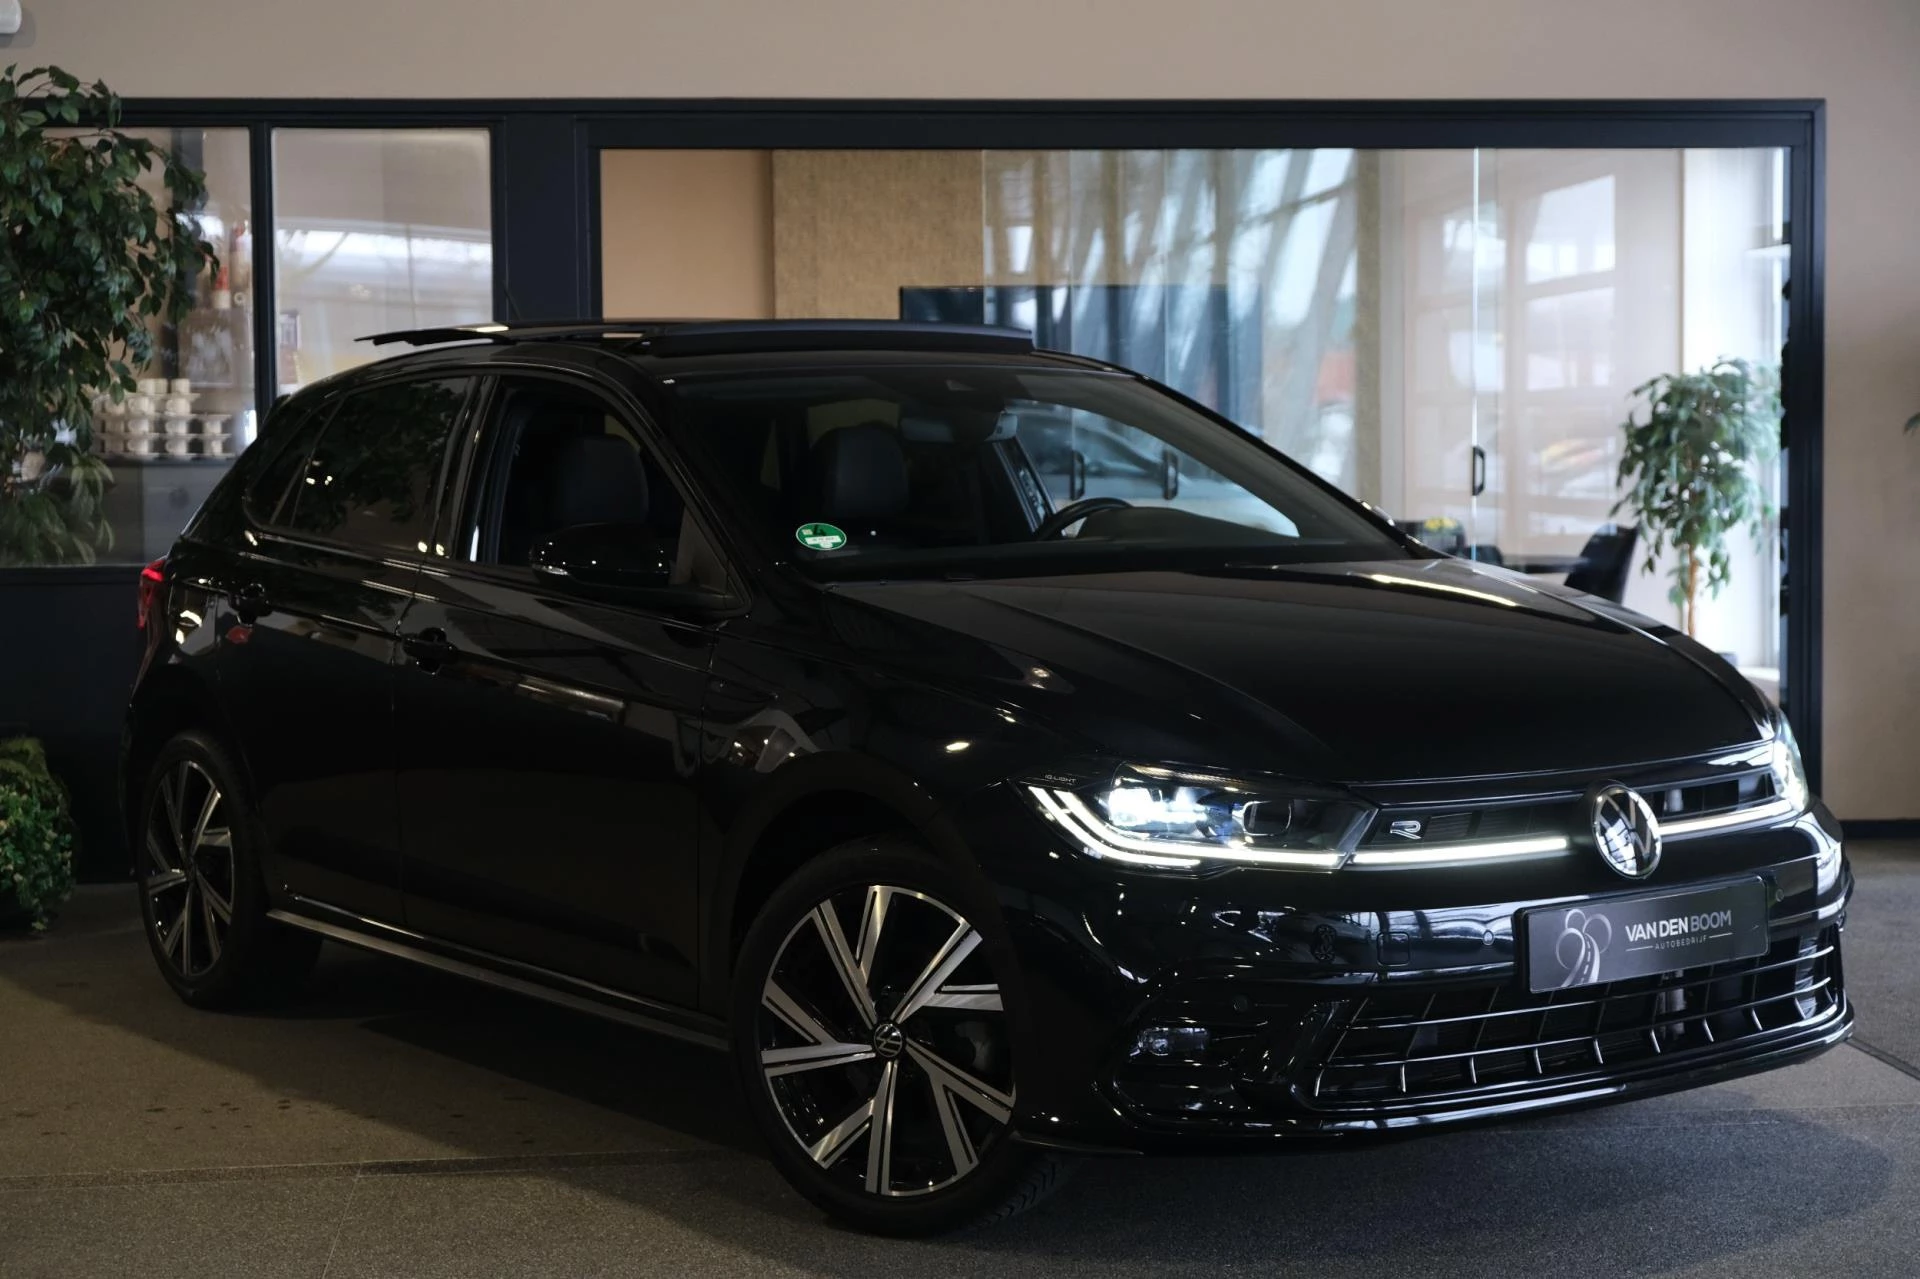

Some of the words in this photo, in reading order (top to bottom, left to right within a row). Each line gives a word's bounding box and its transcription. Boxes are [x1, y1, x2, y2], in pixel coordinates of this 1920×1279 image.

[1625, 921, 1657, 942] VAN
[1659, 916, 1689, 938] DEN
[1690, 910, 1732, 932] BOOM
[1655, 935, 1707, 950] AUTOBEDRIJF
